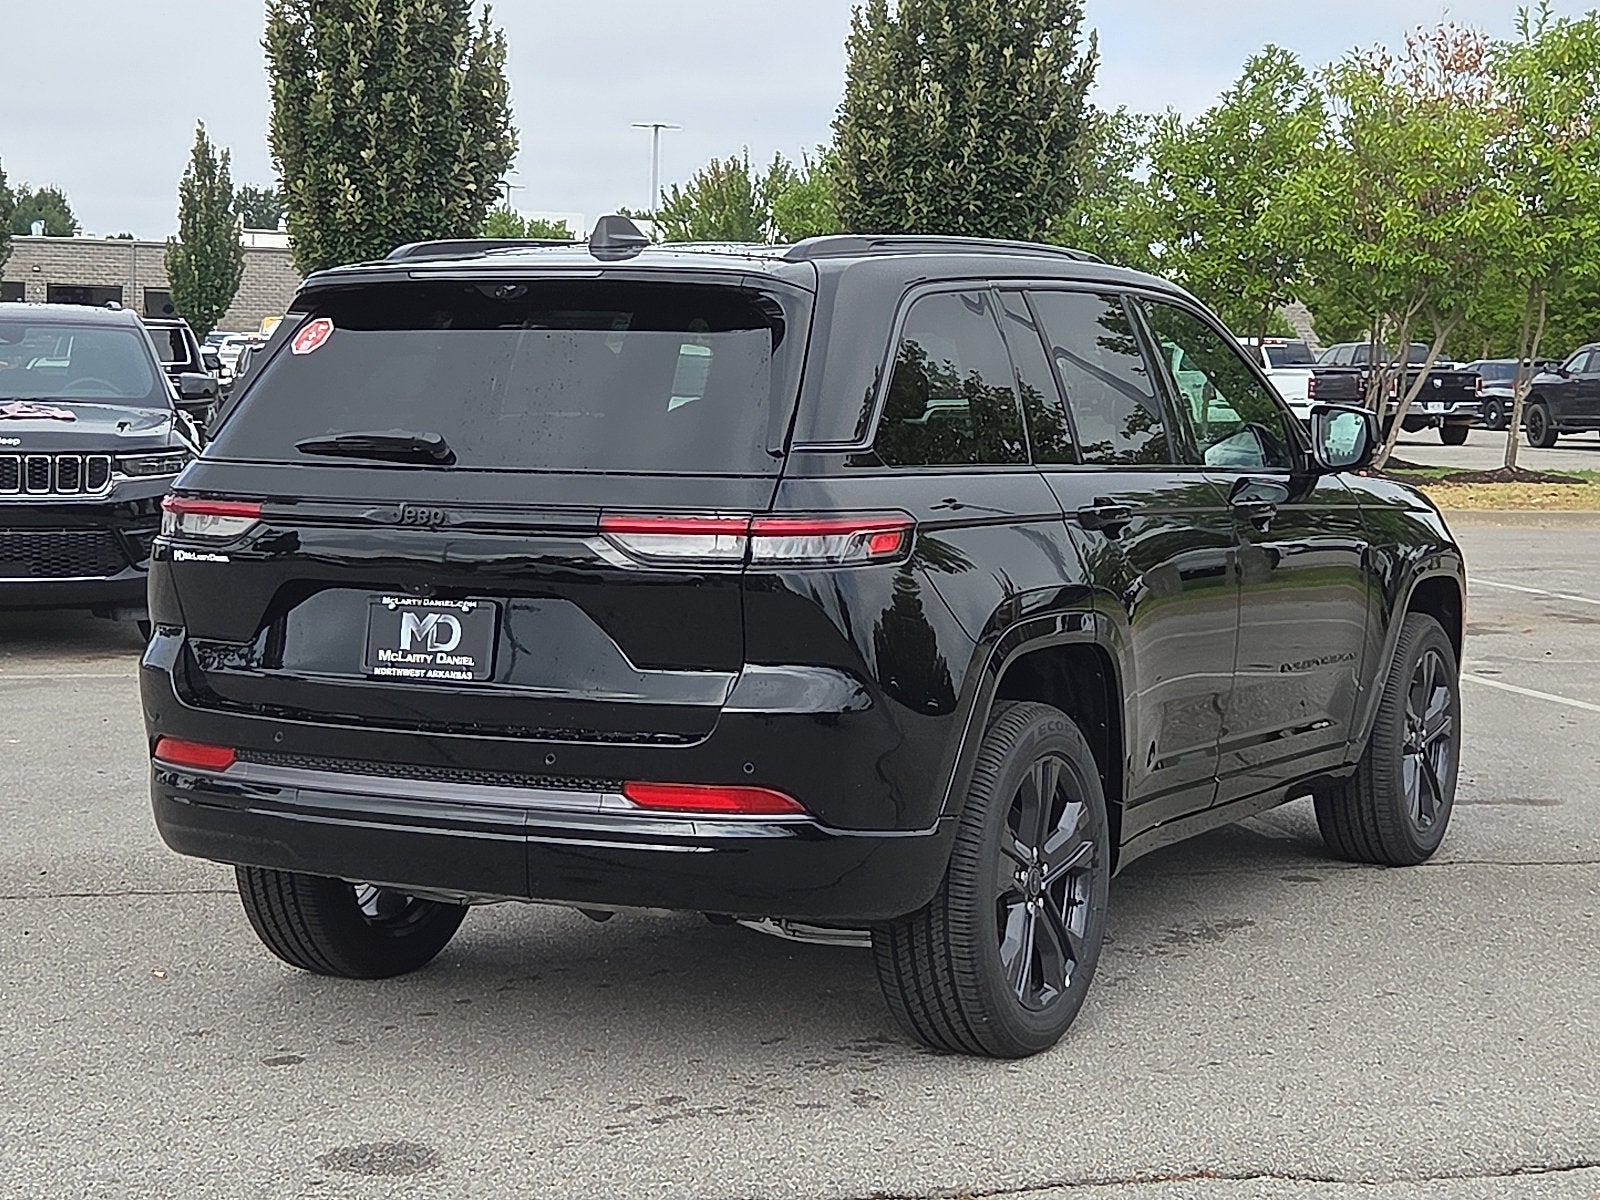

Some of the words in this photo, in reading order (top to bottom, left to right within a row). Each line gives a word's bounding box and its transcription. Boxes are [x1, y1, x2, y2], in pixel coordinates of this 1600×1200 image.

[390, 502, 444, 524] Jeep
[400, 611, 462, 652] MD
[374, 667, 426, 678] NORTHWEST
